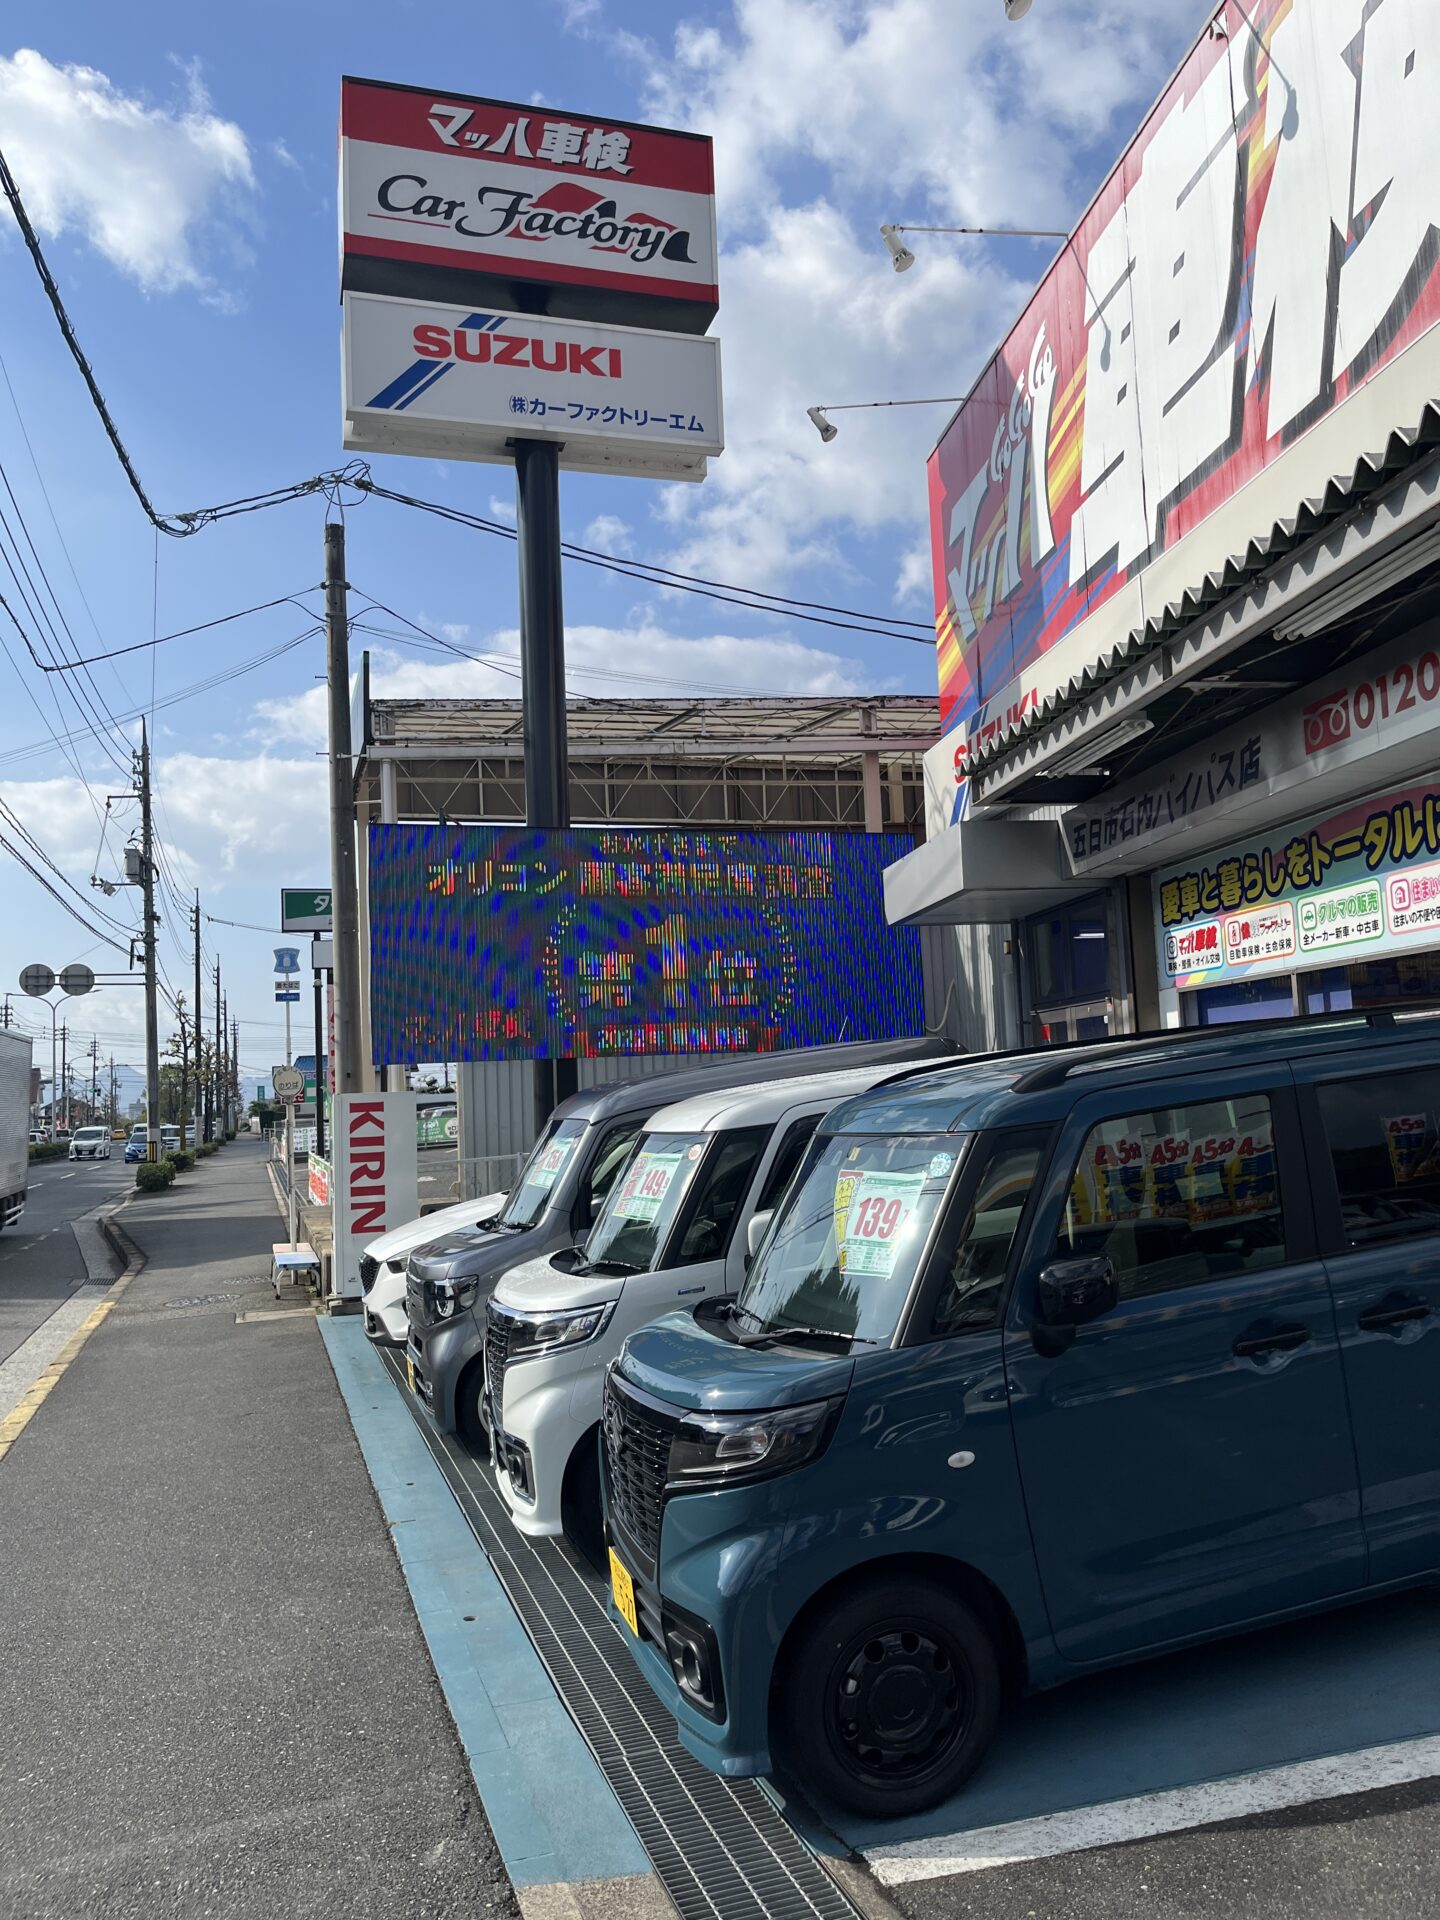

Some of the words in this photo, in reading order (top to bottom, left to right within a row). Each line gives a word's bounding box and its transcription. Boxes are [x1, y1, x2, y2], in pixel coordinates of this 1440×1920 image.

[427, 104, 634, 175] マッハ車検
[377, 175, 465, 221] Car
[455, 187, 666, 262] Factory
[413, 324, 622, 379] SUZUKI
[1354, 652, 1440, 729] 0120
[1073, 735, 1261, 858] 五日市石内バイパス店
[314, 895, 332, 912] タ
[1319, 890, 1378, 923] クルマの販売
[1230, 939, 1292, 960] 自動車保険・生命保険
[1303, 920, 1379, 946] 全メーカー新車・中古車
[349, 1102, 386, 1234] KIRIN
[640, 1169, 667, 1197] 149
[853, 1197, 902, 1239] 139
